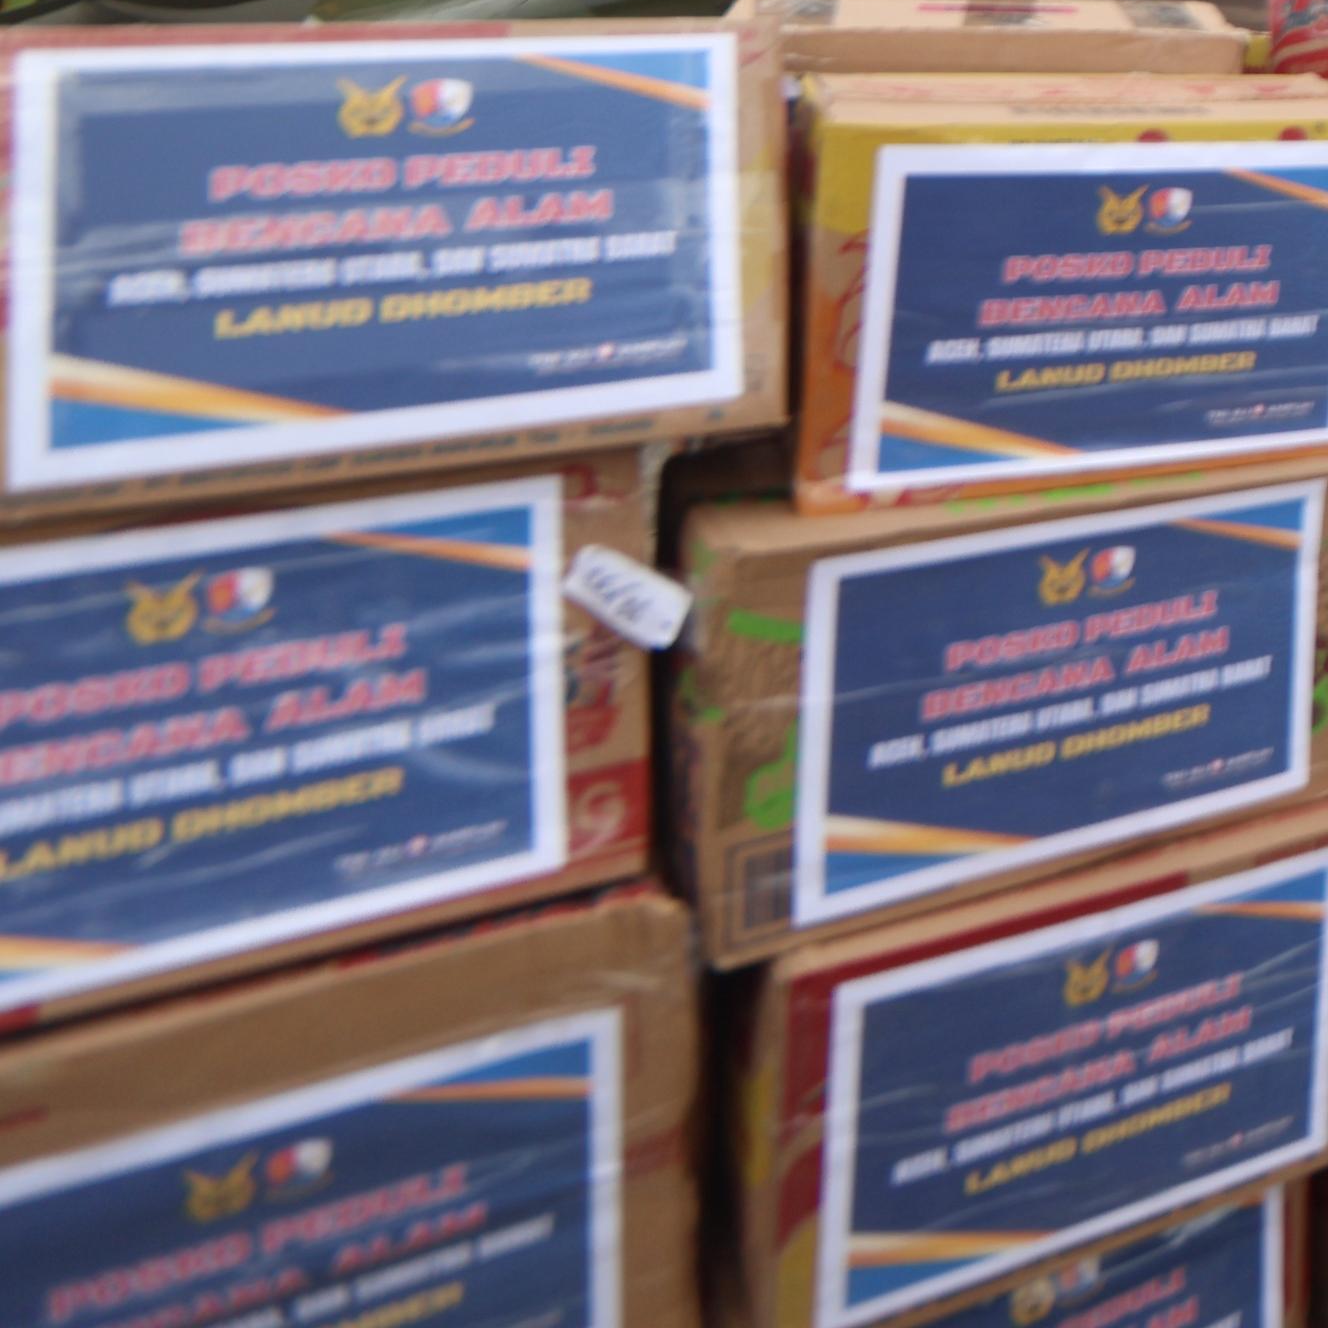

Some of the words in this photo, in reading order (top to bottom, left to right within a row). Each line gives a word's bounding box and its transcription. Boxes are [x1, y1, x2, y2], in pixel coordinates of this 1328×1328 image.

[210, 156, 397, 200] POSKO
[402, 144, 595, 187] PEDULI
[178, 202, 453, 255] BENCANA
[464, 188, 615, 229] ALAM
[1002, 251, 1134, 283] POSKO
[1135, 245, 1271, 276] PEDULI
[214, 297, 373, 335] LANUD
[380, 276, 592, 319] DHOMBER
[977, 289, 1169, 326] BENCANA
[1174, 281, 1281, 311] ALAM
[996, 362, 1106, 390] LANUD
[1109, 350, 1256, 380] DHOMBER
[200, 624, 409, 691] PEDULI
[944, 618, 1078, 673] POSKO
[1081, 590, 1218, 644] PEDULI
[264, 669, 429, 733] ALAM
[920, 652, 1116, 722] BENCANA
[1123, 626, 1231, 674] ALAM
[943, 739, 1056, 786] LANUD
[1060, 702, 1210, 758] DHOMBER
[171, 766, 407, 845] DHOMBER
